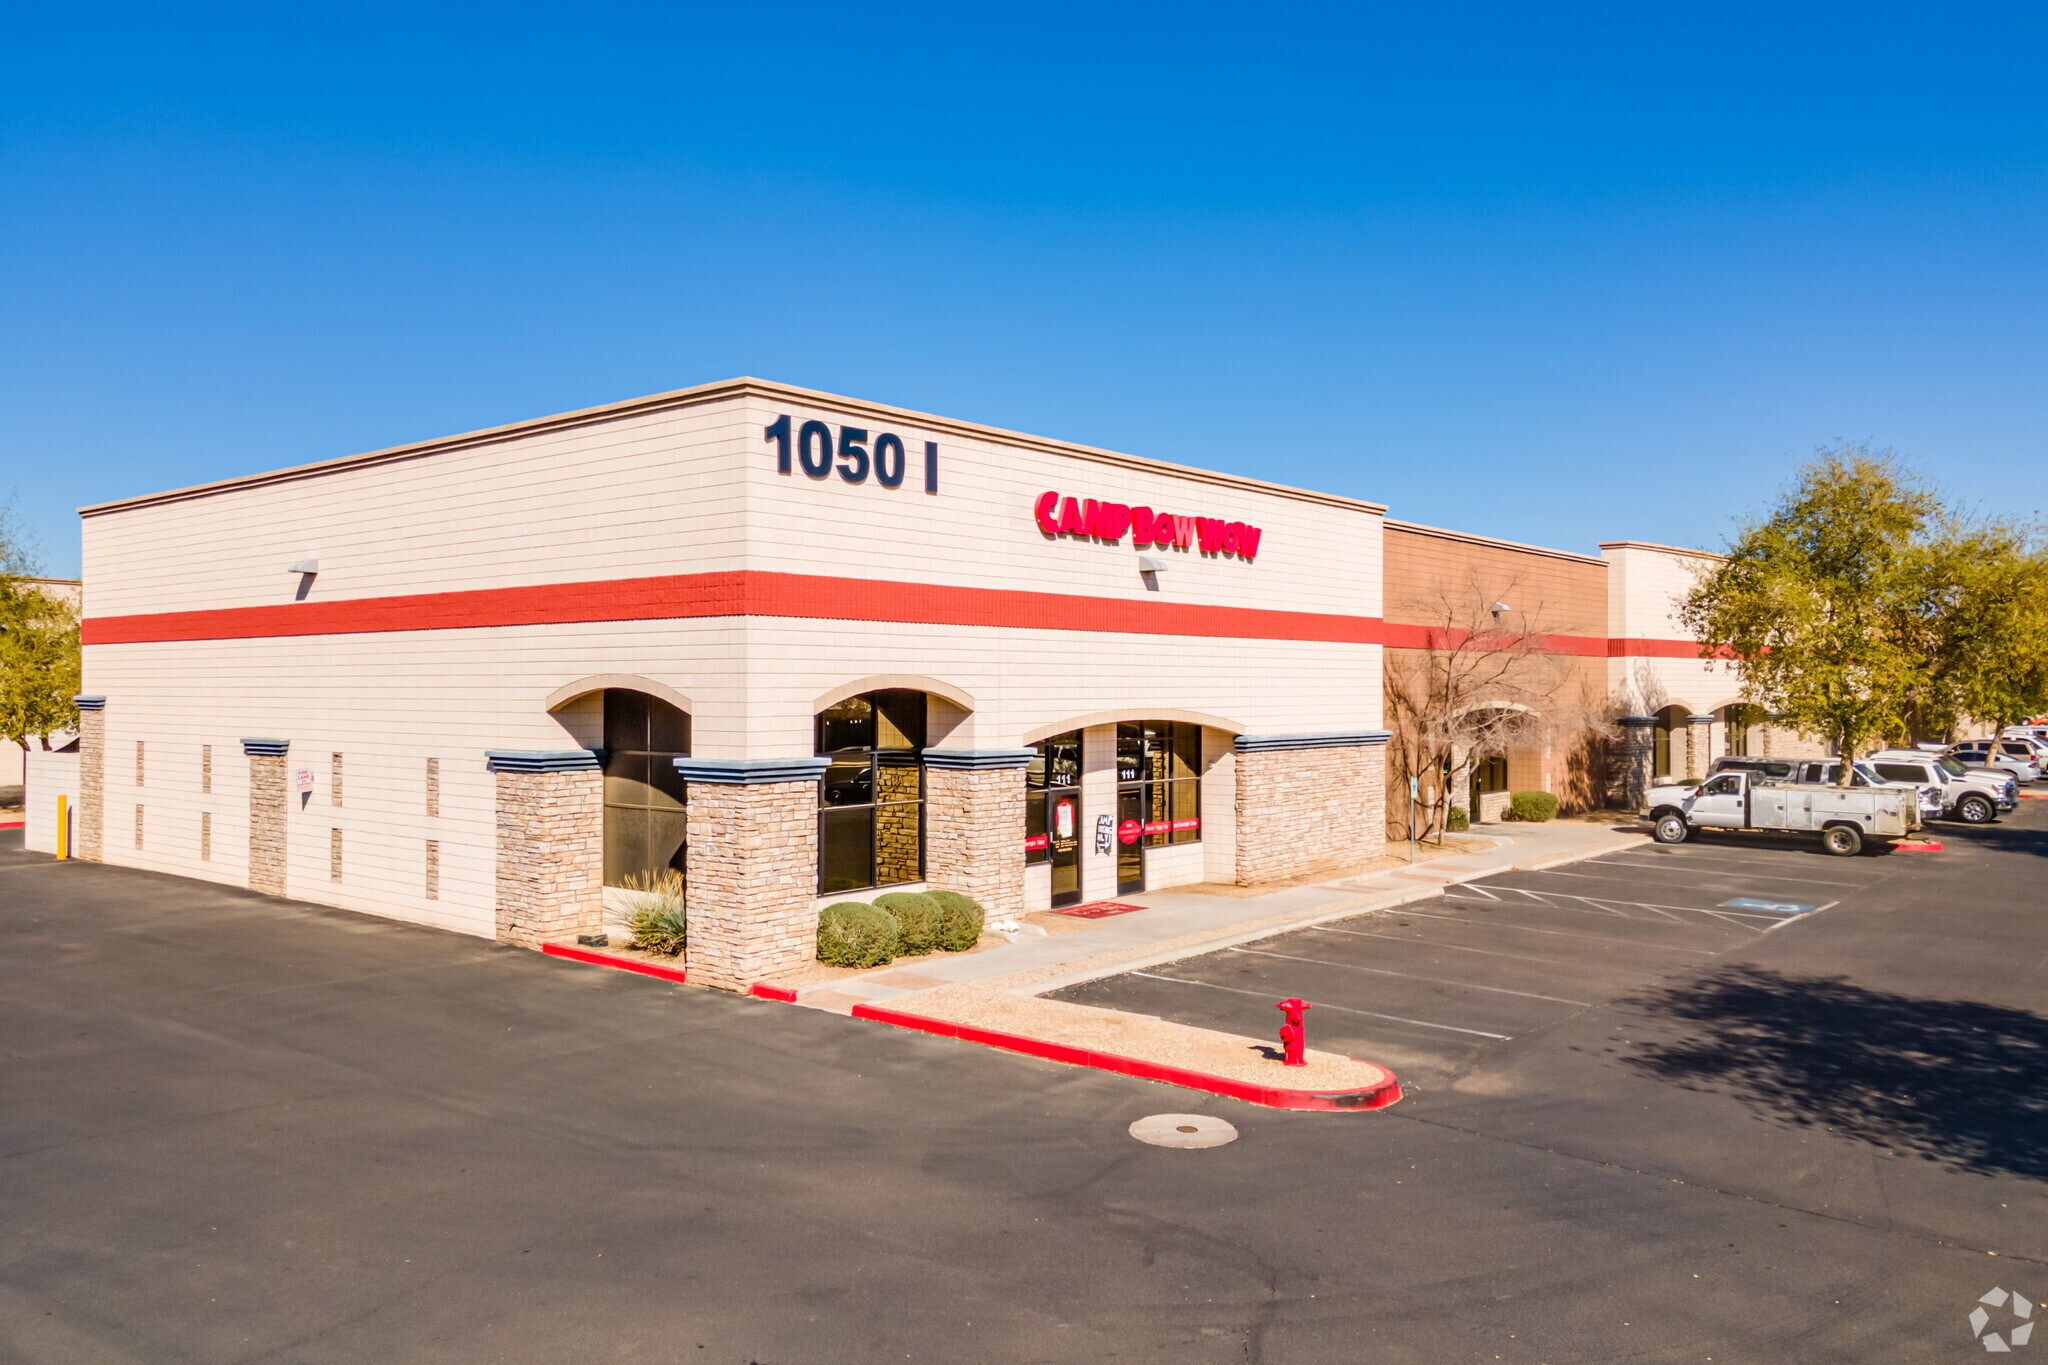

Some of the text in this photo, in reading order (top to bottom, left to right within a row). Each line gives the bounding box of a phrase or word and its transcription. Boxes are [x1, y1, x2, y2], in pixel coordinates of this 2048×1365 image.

[764, 414, 905, 489] 1050
[1034, 490, 1262, 559] CAMP BOW WOW
[1056, 774, 1071, 784] 111
[1121, 769, 1135, 779] 111
